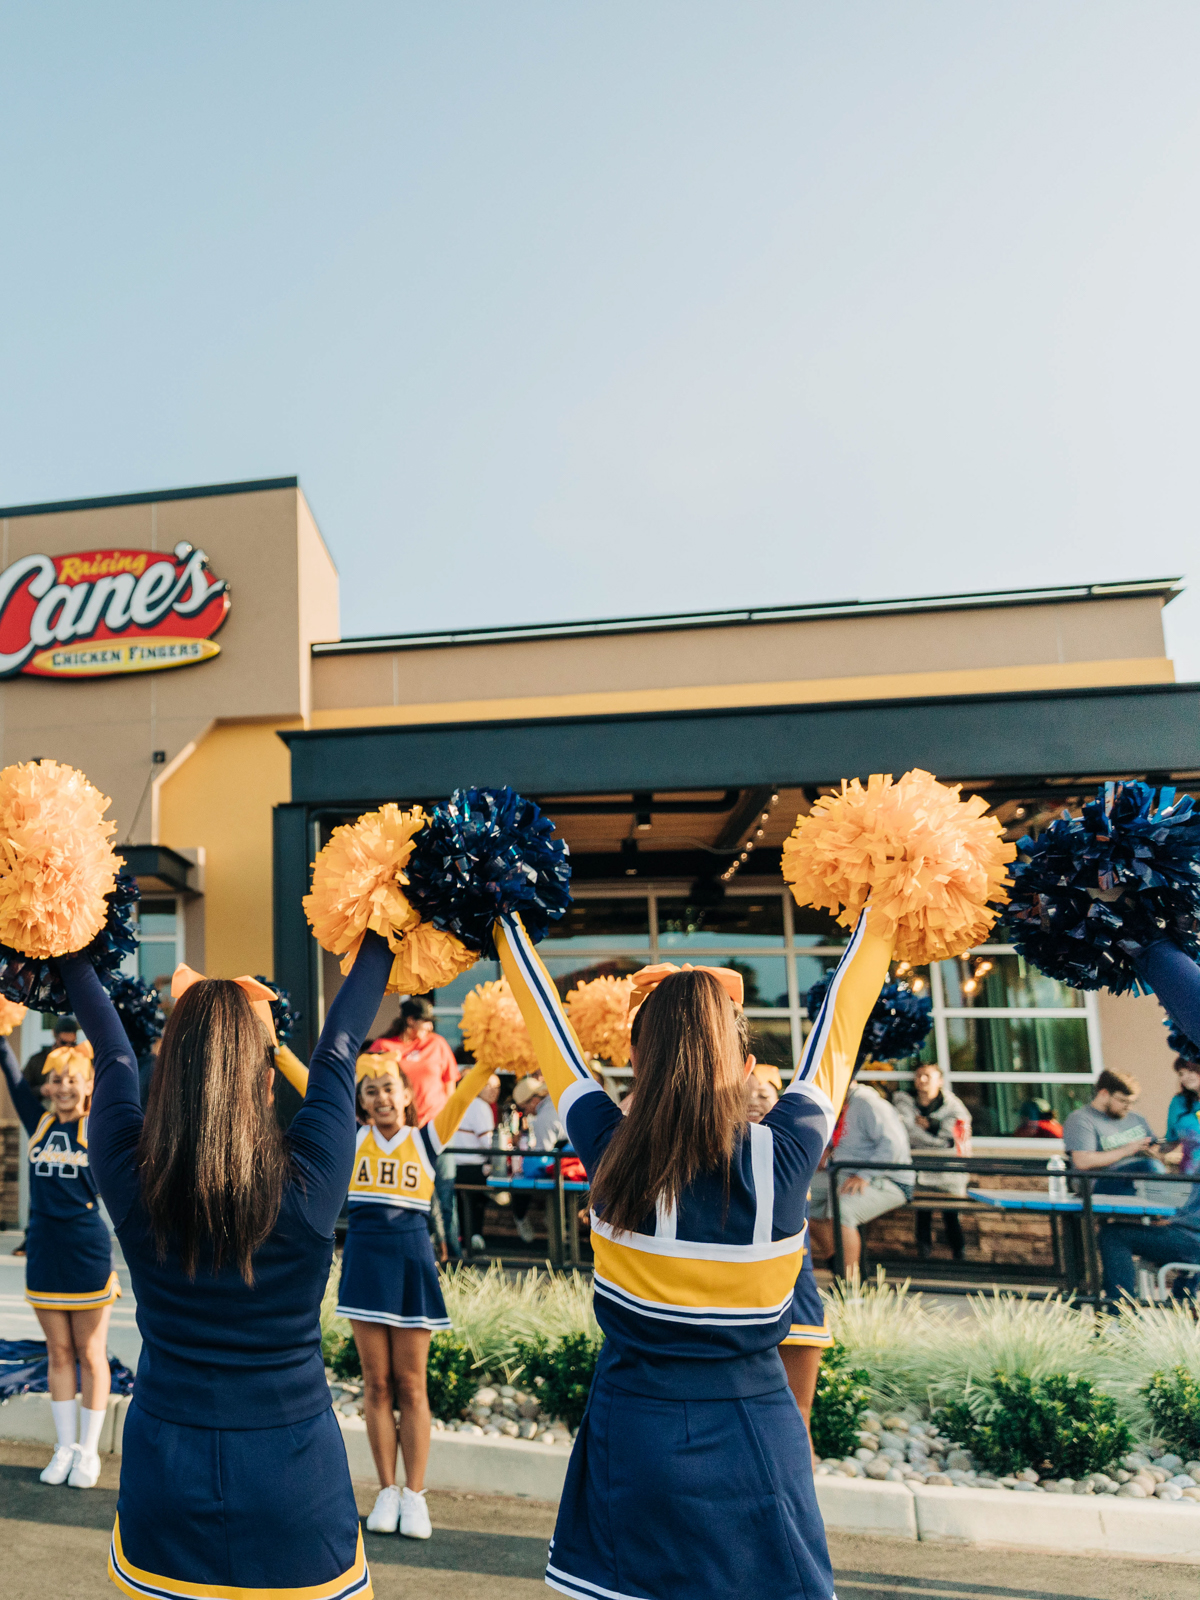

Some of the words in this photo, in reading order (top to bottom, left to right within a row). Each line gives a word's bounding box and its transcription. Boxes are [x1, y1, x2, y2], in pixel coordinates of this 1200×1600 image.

[58, 551, 148, 583] Raising
[52, 650, 122, 667] CHICKEN
[129, 643, 202, 661] FINGERS
[356, 1157, 420, 1191] AHS
